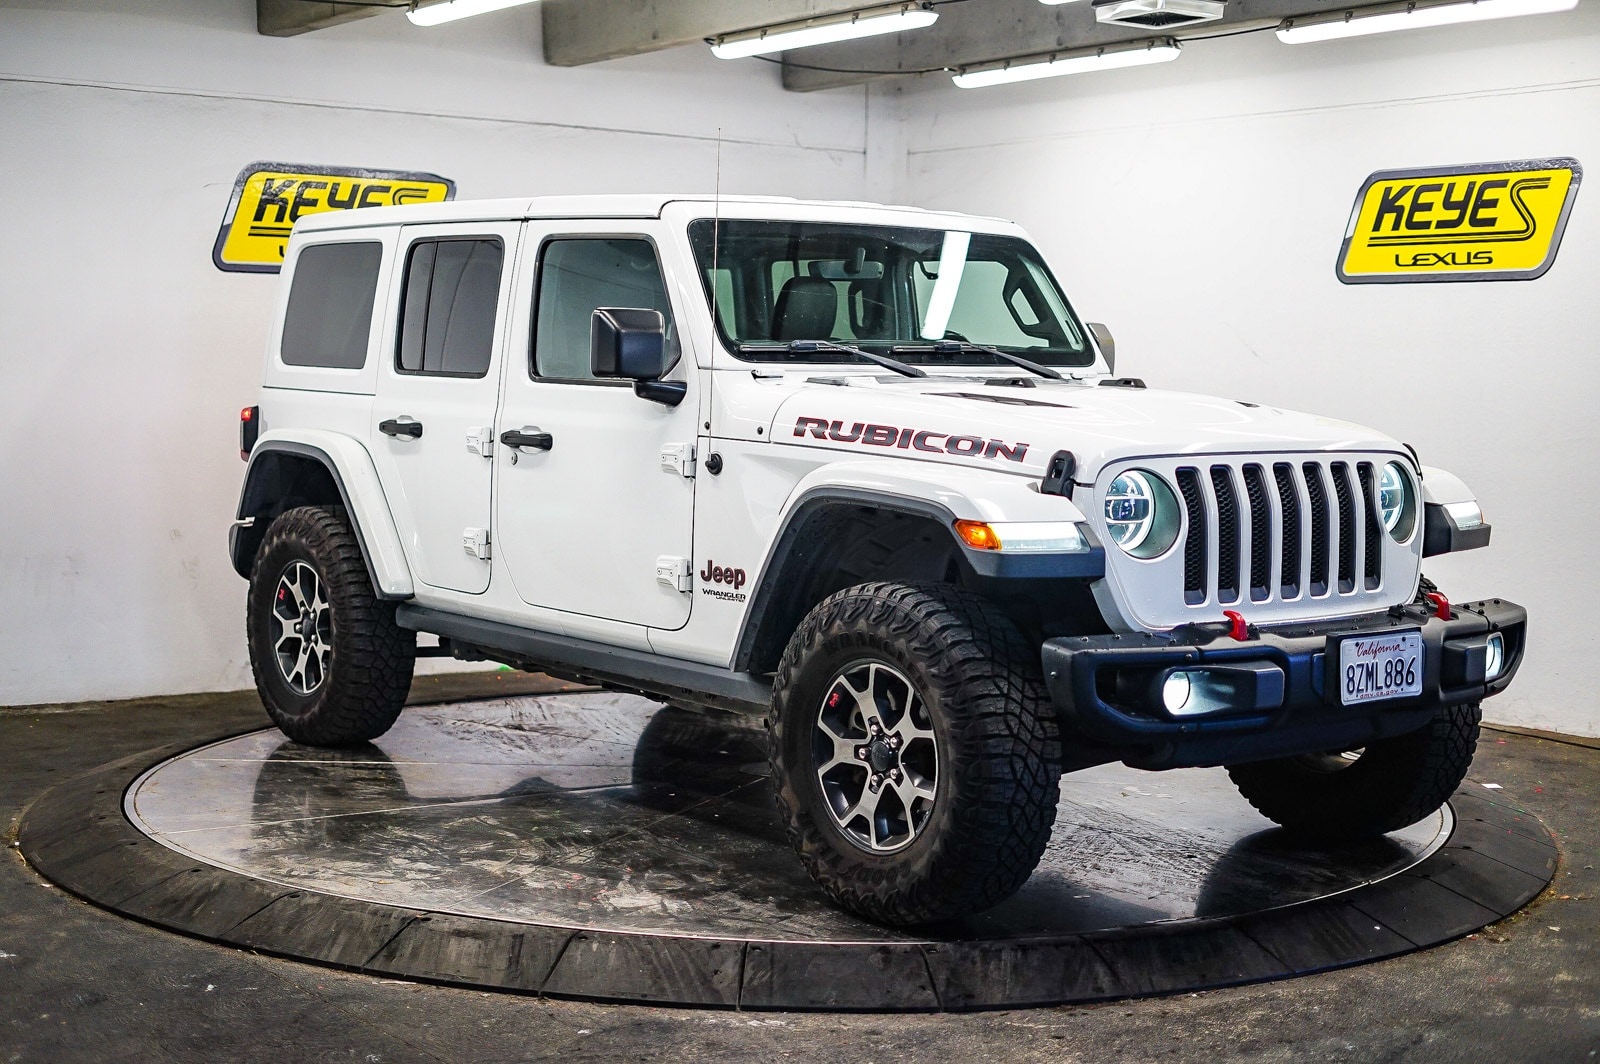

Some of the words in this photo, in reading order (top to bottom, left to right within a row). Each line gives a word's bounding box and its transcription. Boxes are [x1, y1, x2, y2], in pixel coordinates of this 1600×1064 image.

[1370, 177, 1551, 240] KEYES
[1394, 250, 1494, 267] LEXUS
[793, 416, 1030, 463] RUBICON
[700, 559, 746, 590] Jeep
[702, 588, 746, 600] WRANGLER
[1356, 640, 1406, 660] California
[1346, 655, 1417, 696] 8ZML886
